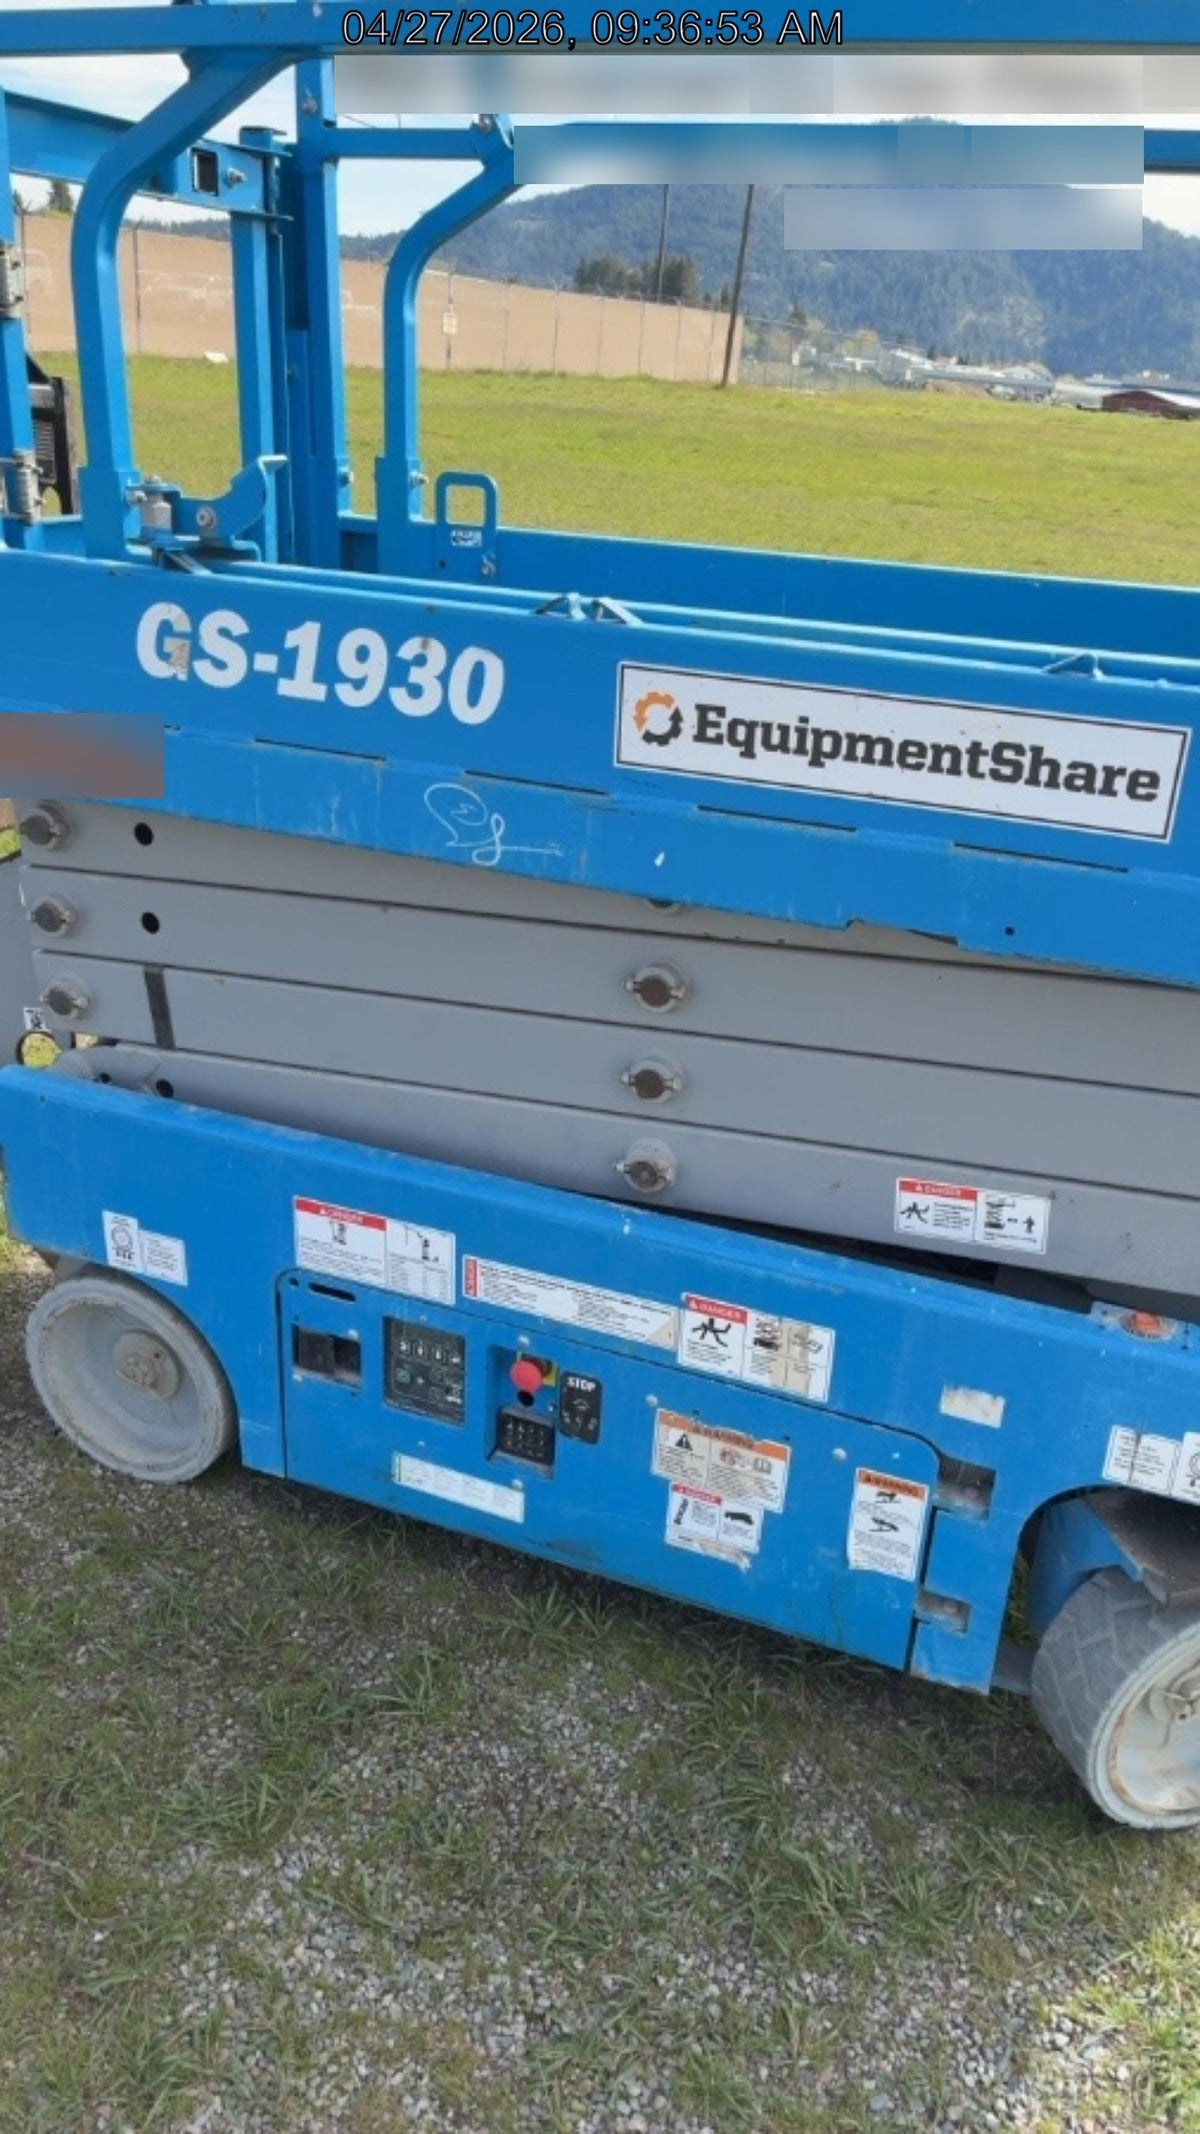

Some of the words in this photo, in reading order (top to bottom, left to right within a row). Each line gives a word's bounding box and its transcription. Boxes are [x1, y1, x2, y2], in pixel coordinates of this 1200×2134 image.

[136, 602, 505, 726] GS-1930
[692, 703, 1160, 802] EquipmentShare
[566, 1376, 597, 1392] STOP
